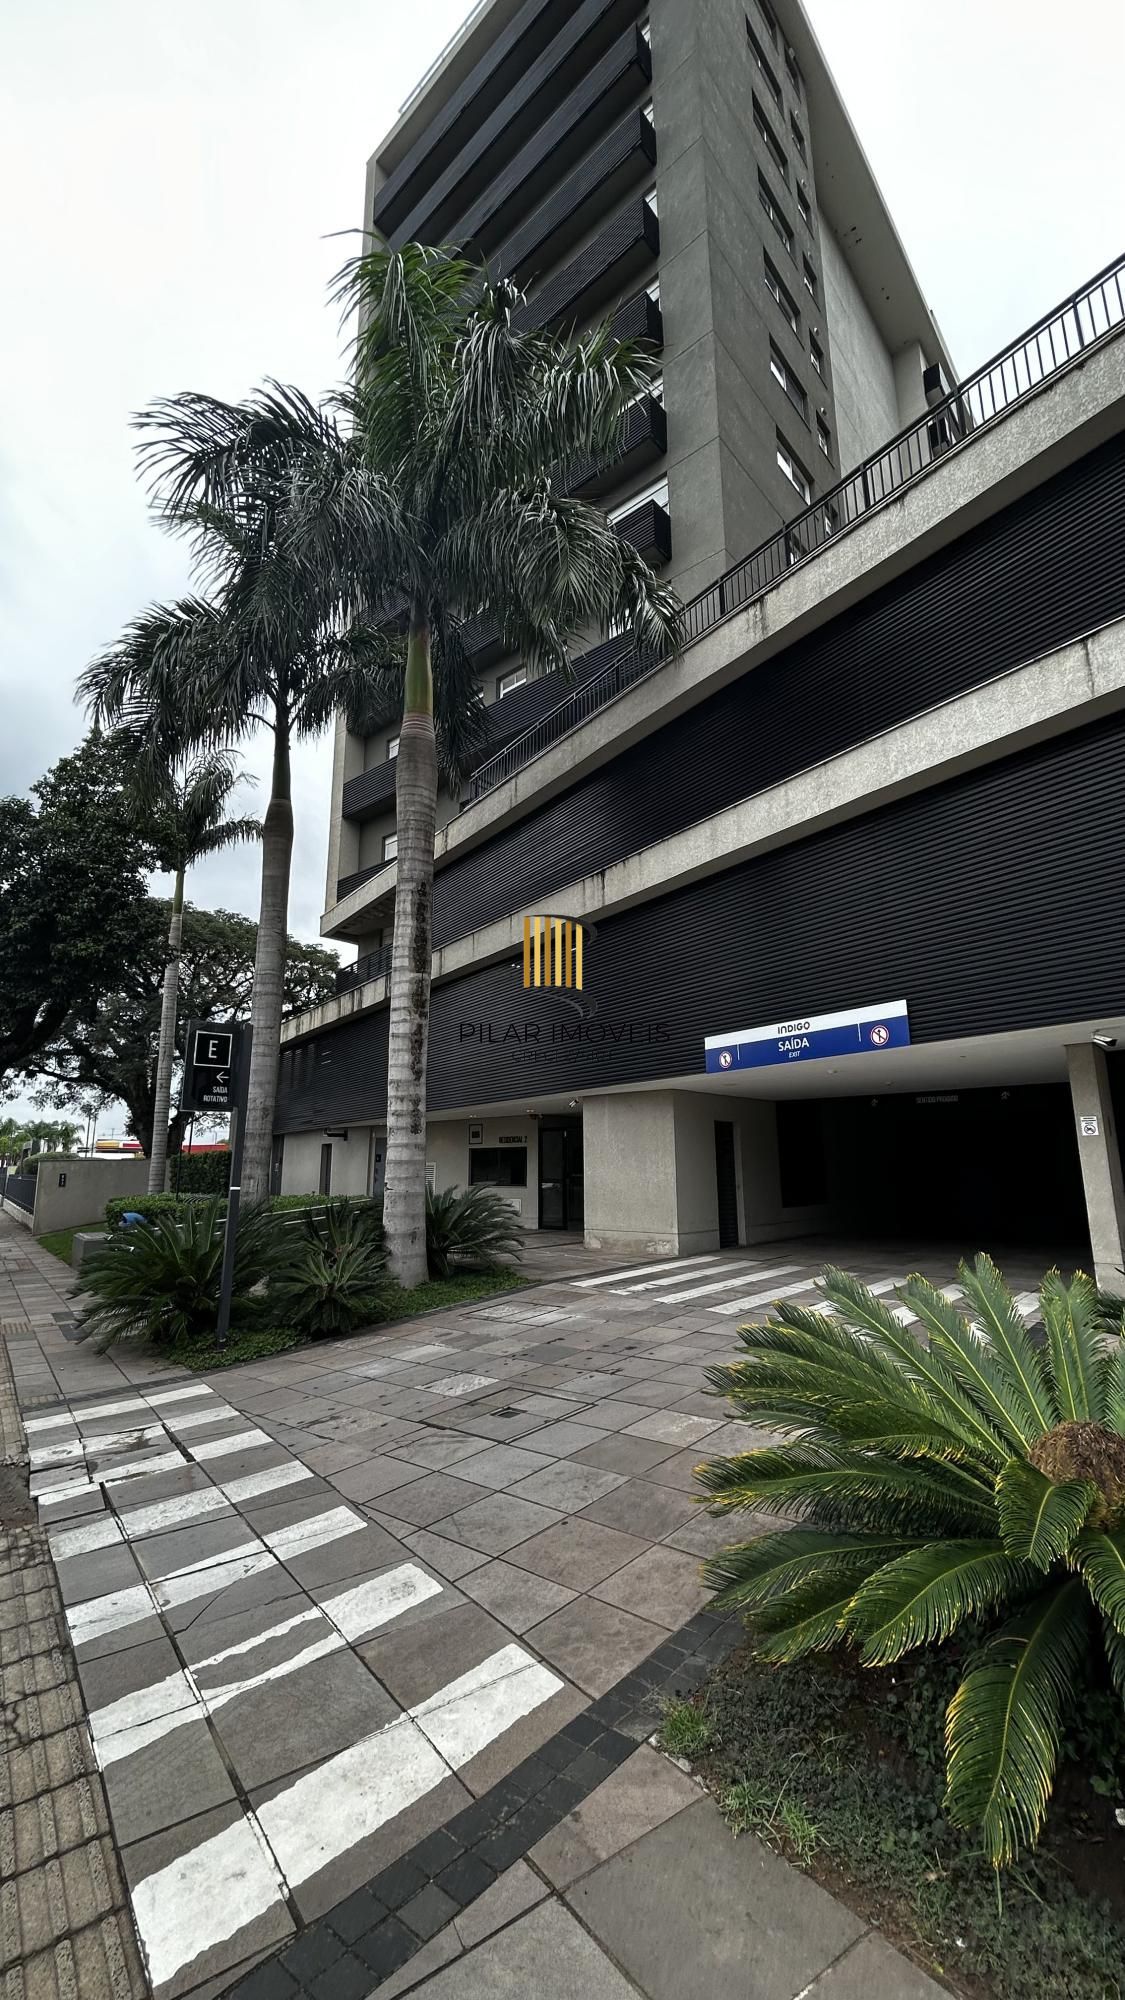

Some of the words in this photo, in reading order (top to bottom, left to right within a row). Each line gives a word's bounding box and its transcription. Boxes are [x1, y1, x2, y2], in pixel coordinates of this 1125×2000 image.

[777, 1021, 811, 1035] INDIGO
[208, 1039, 219, 1059] E
[778, 1038, 810, 1052] SAÍDA
[788, 1050, 801, 1059] EXIT
[203, 1095, 228, 1103] ROTATIVO
